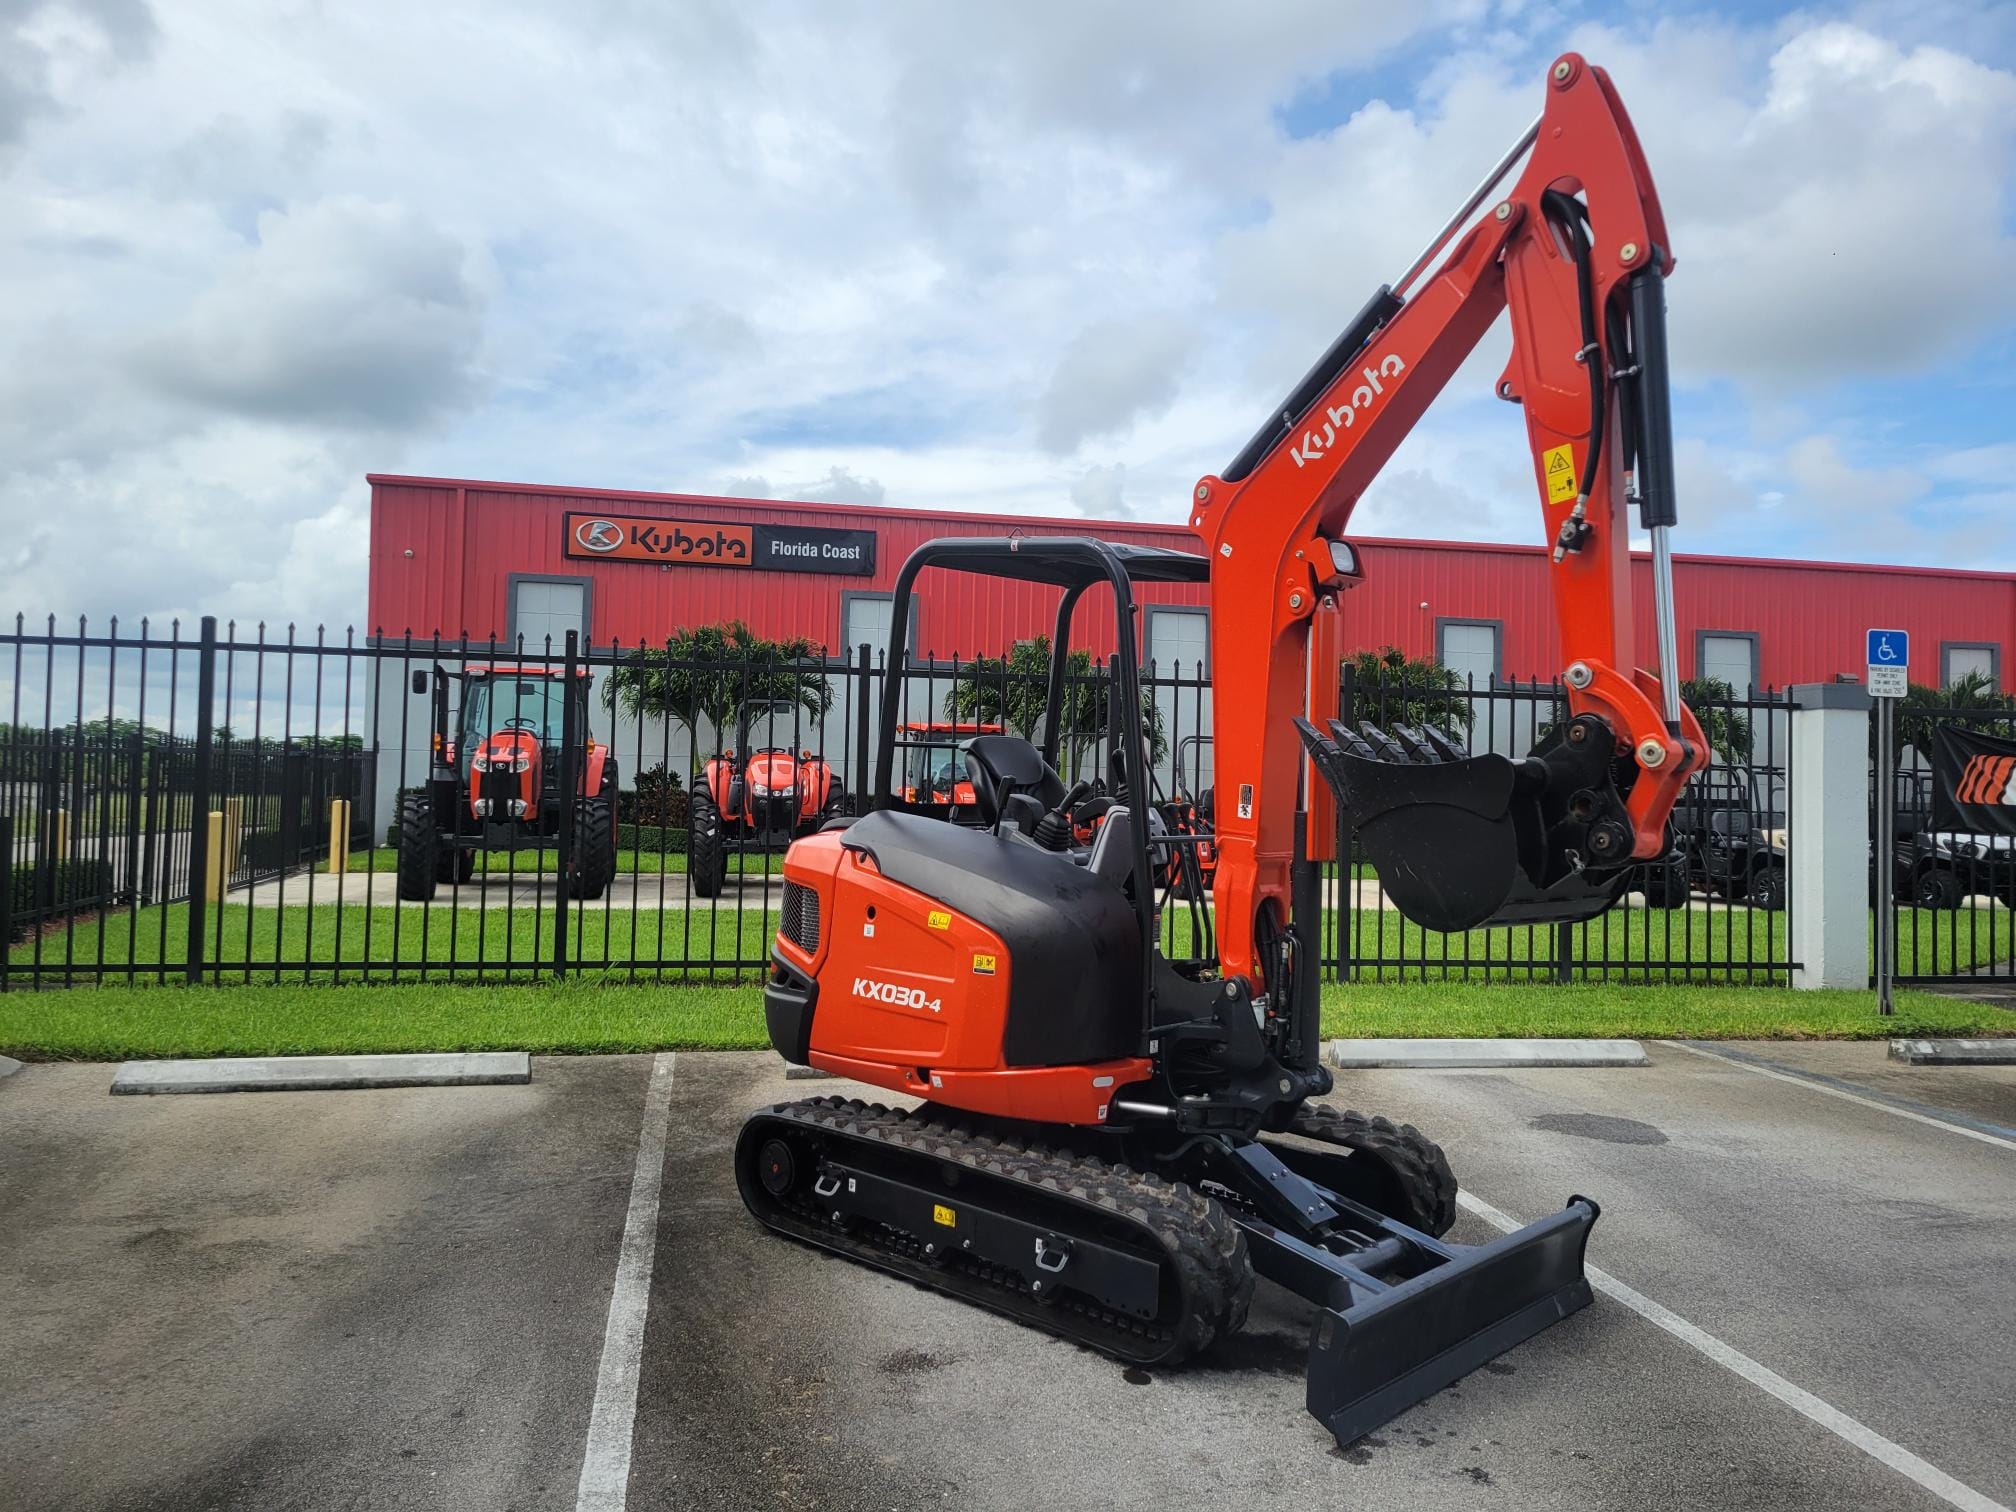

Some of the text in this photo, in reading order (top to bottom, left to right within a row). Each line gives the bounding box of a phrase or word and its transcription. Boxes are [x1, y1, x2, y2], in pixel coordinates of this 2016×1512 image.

[1290, 354, 1406, 468] Kubota
[631, 525, 746, 558] Kubota
[771, 540, 860, 560] Florida Coast
[852, 977, 942, 1013] KX030-4
